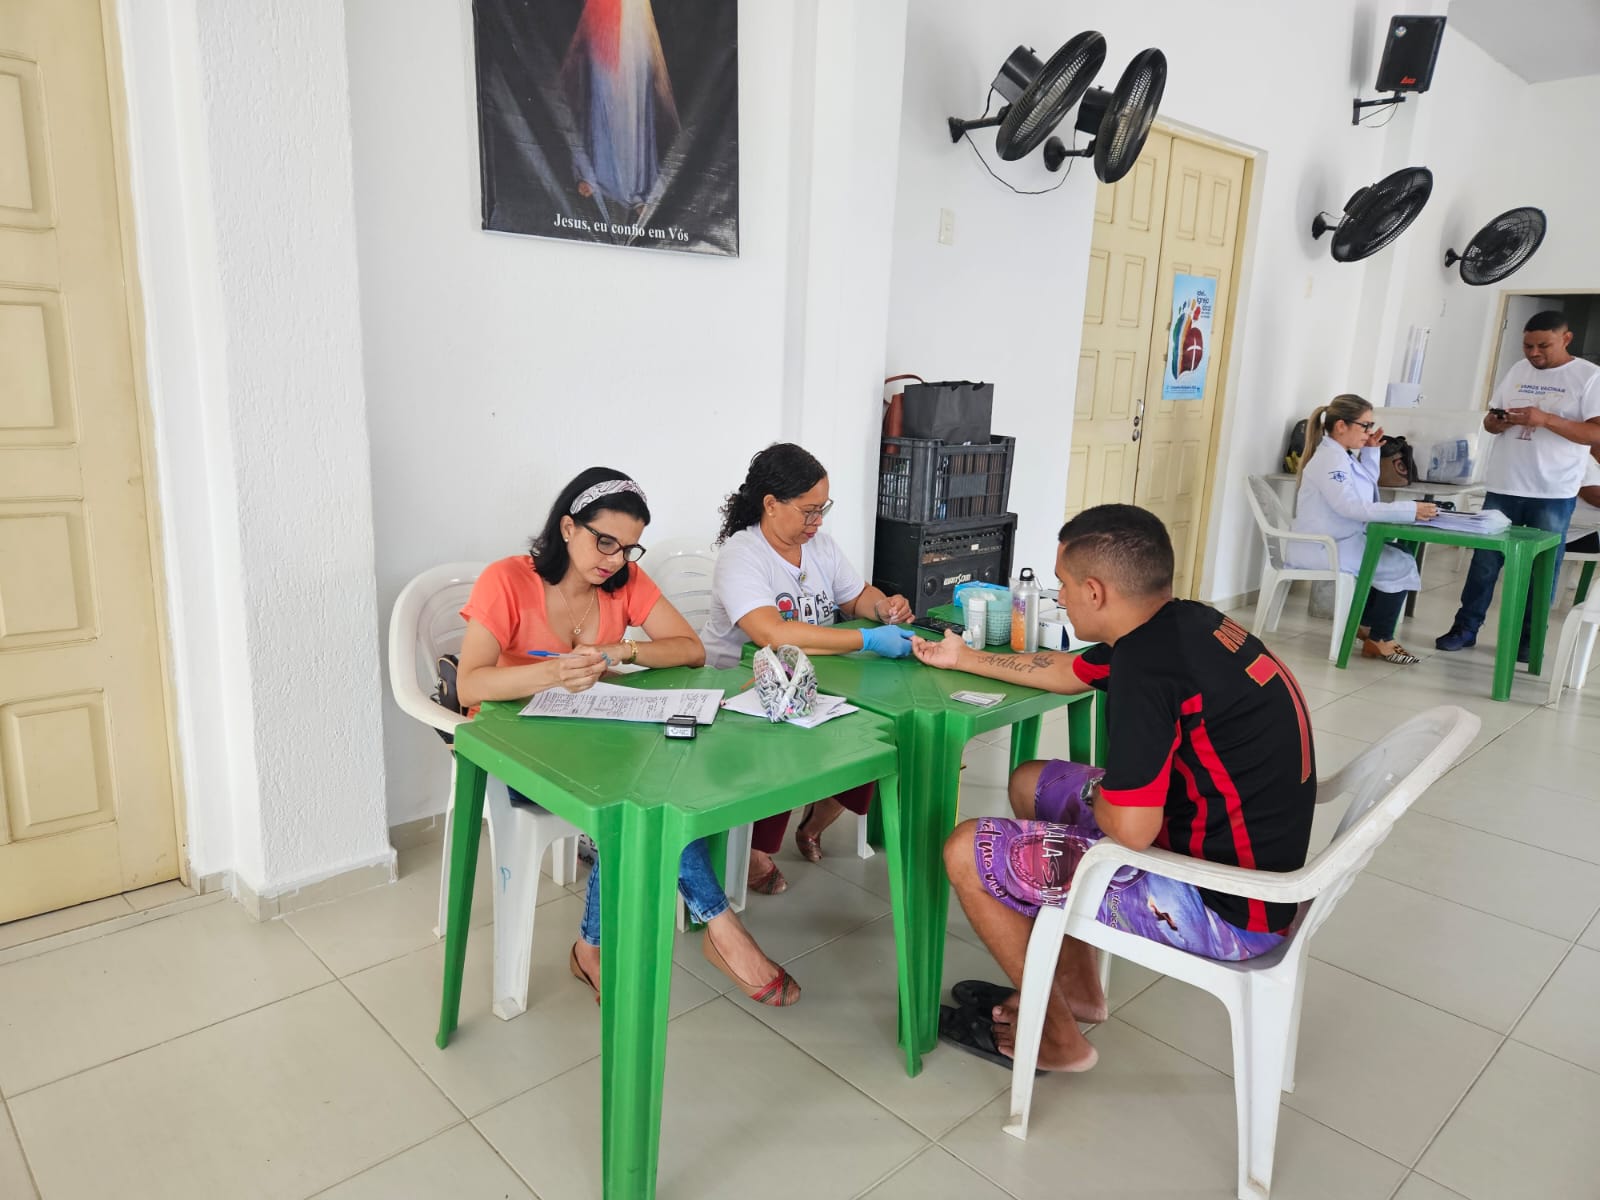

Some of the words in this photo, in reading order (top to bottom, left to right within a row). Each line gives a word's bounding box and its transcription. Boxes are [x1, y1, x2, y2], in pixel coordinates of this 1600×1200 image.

[553, 213, 591, 232] Jesus,
[594, 222, 608, 232] eu
[611, 223, 645, 237] confio
[648, 228, 665, 239] em
[668, 227, 689, 241] Vós
